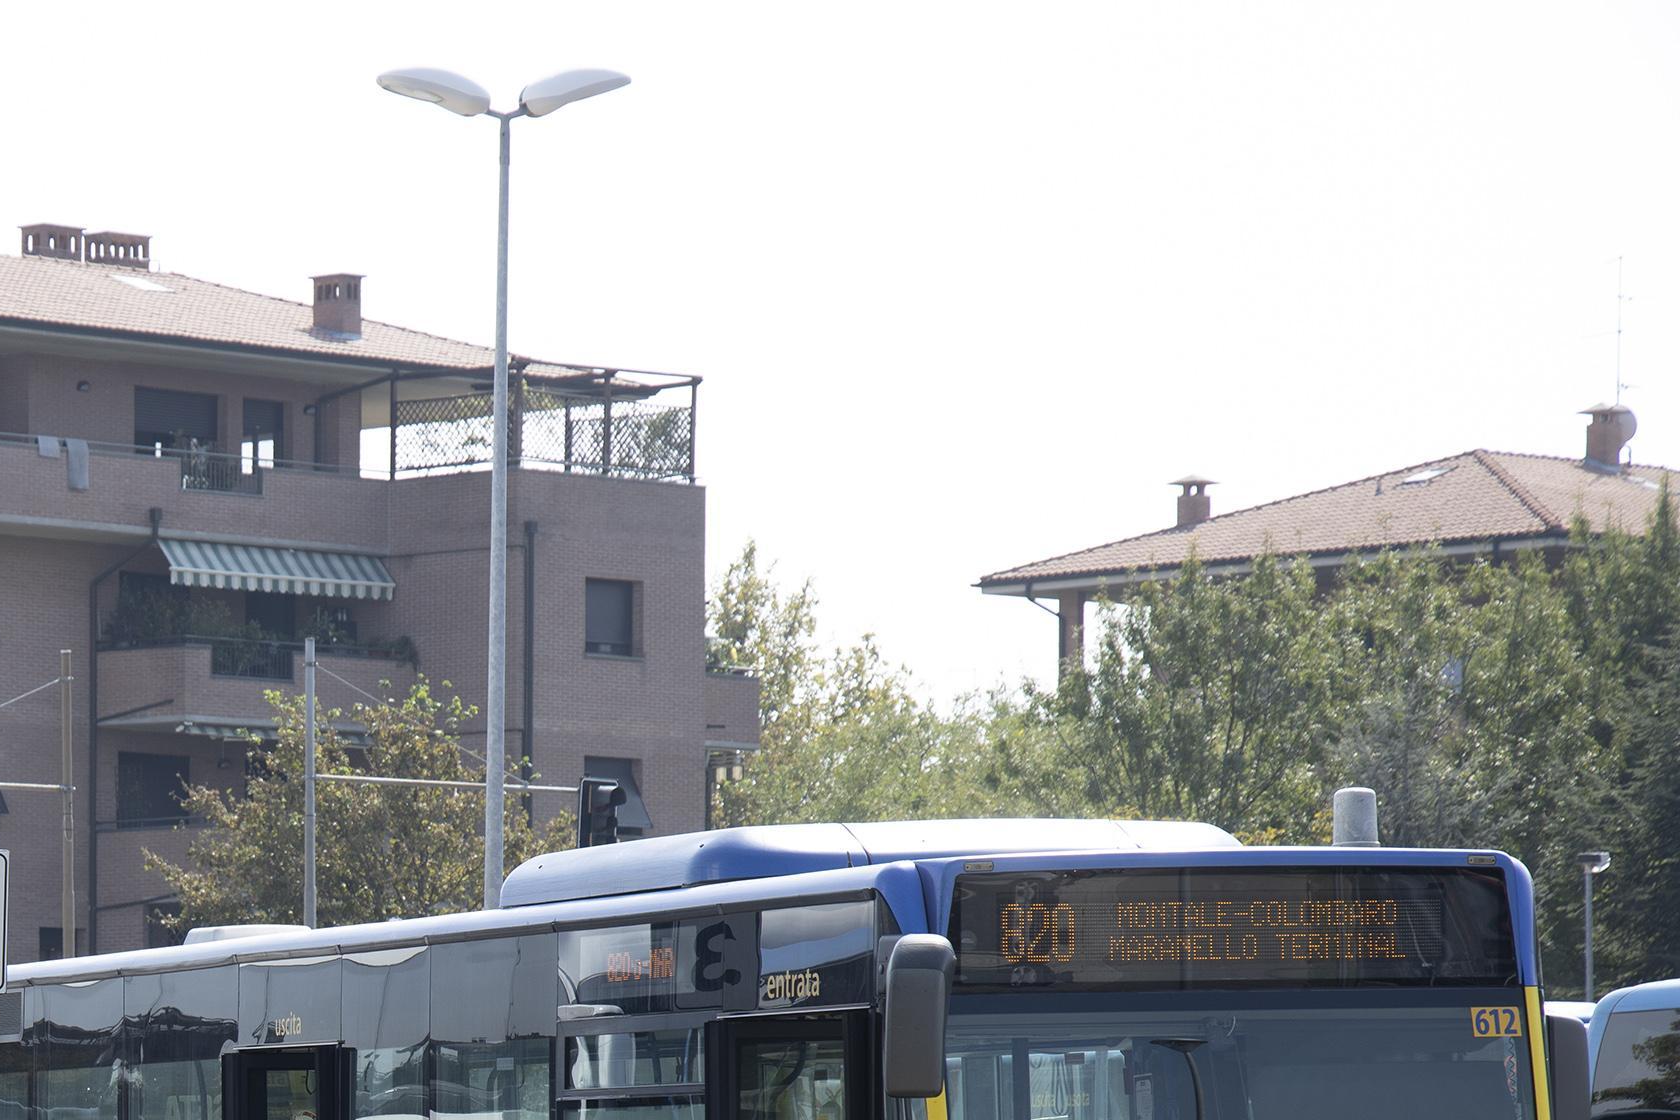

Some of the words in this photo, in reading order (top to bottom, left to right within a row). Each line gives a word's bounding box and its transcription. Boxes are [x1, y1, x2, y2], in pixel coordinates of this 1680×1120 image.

[1109, 933, 1258, 961] MARANELLO
[1276, 932, 1407, 960] TERMINAL
[766, 968, 821, 1000] entrata
[274, 1012, 302, 1036] uscita
[1475, 1008, 1518, 1035] 612
